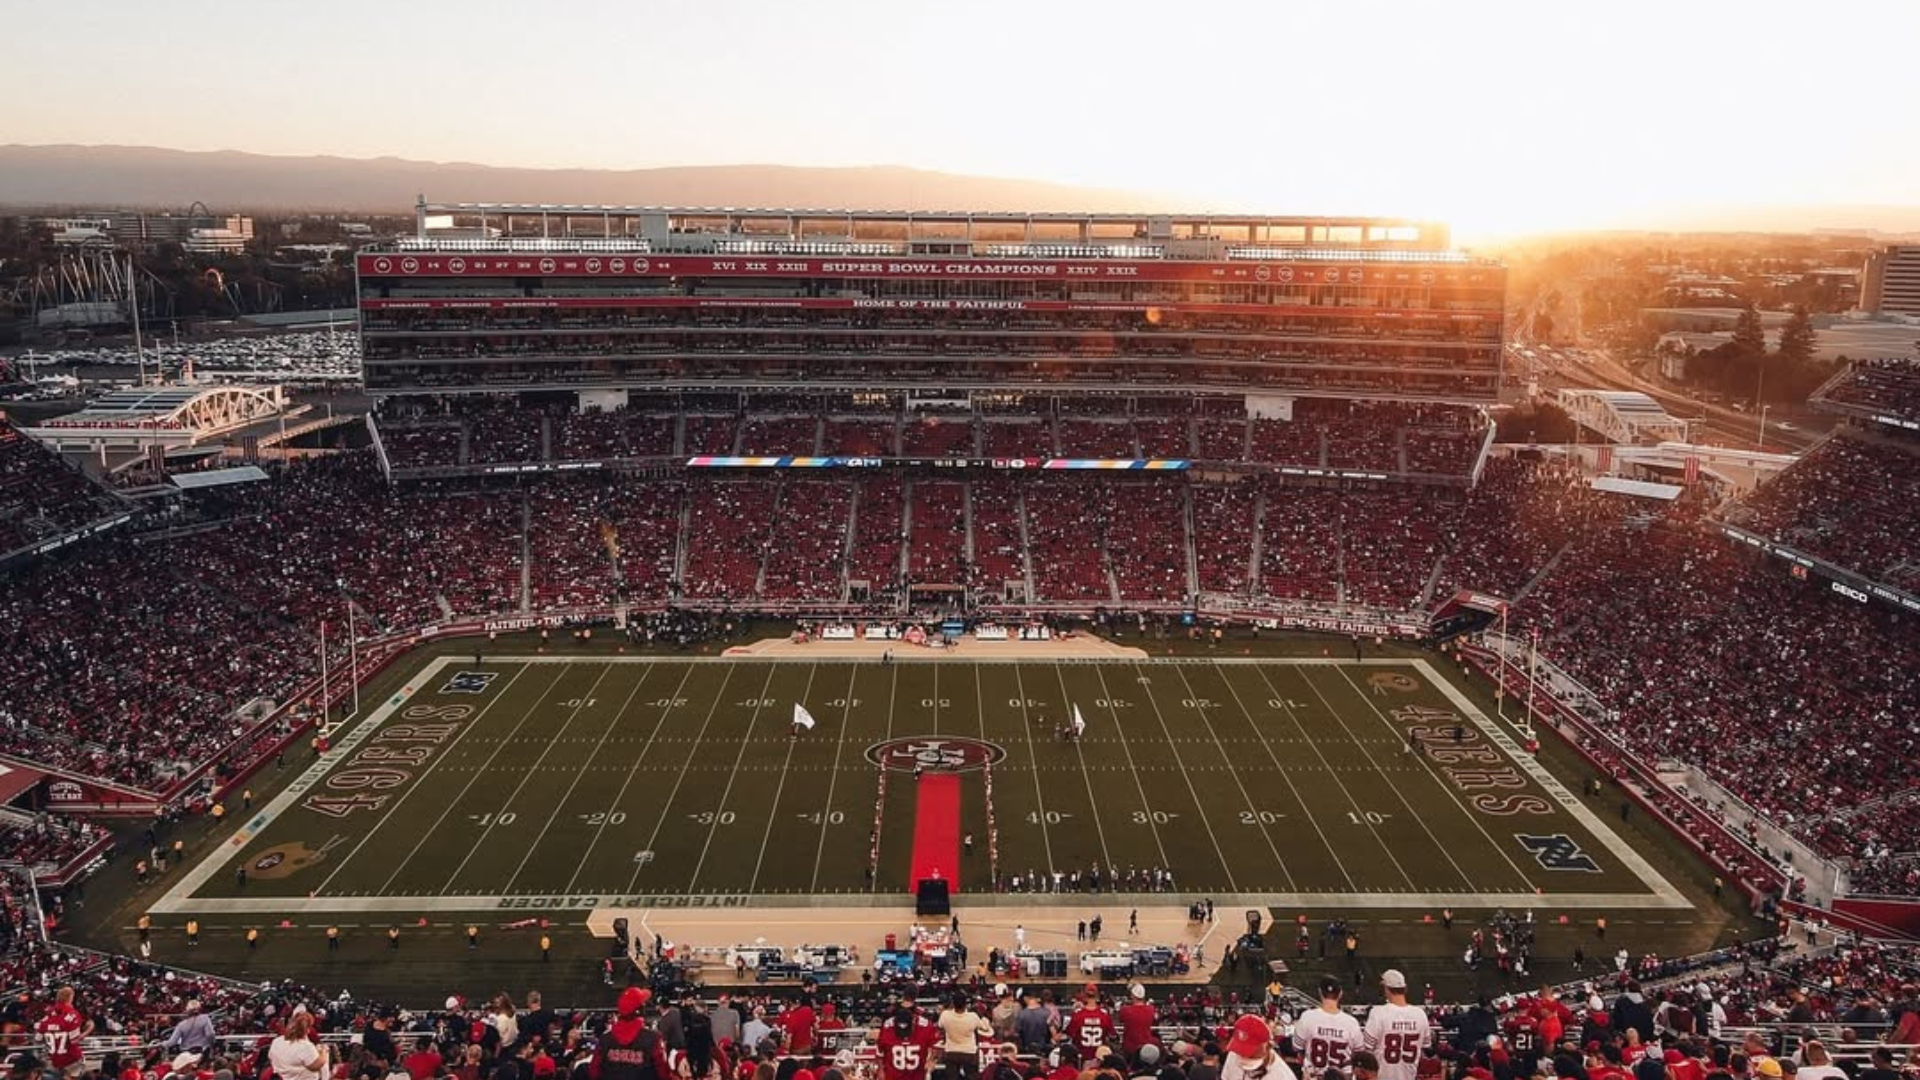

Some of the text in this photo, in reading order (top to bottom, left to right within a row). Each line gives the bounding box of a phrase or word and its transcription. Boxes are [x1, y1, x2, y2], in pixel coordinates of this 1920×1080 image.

[713, 262, 1138, 275] XVI XIX XXIII SUPER BOWL CHAMPIONS XXIV XXIX
[923, 301, 950, 309] THE
[1832, 581, 1868, 603] GEICO
[484, 618, 536, 631] FAITHFUL
[1339, 622, 1390, 635] FAITHFUL
[302, 703, 476, 817] 49ERS
[1389, 704, 1556, 816] 49ERS
[1513, 755, 1541, 771] ALL
[1535, 775, 1559, 787] OF
[1553, 790, 1578, 805] US
[480, 811, 1382, 826] 10 20 30 40 40 30 20 10
[497, 896, 749, 909] INTERCEPT CANCER
[1318, 1026, 1344, 1038] KITTLE
[1392, 1021, 1416, 1031] KITTLE
[44, 1031, 68, 1055] 97
[823, 1036, 837, 1049] 19
[1080, 1025, 1103, 1047] 52
[1515, 1033, 1533, 1050] 21
[892, 1044, 921, 1070] 85
[1310, 1038, 1349, 1068] 85
[1384, 1033, 1420, 1065] 85
